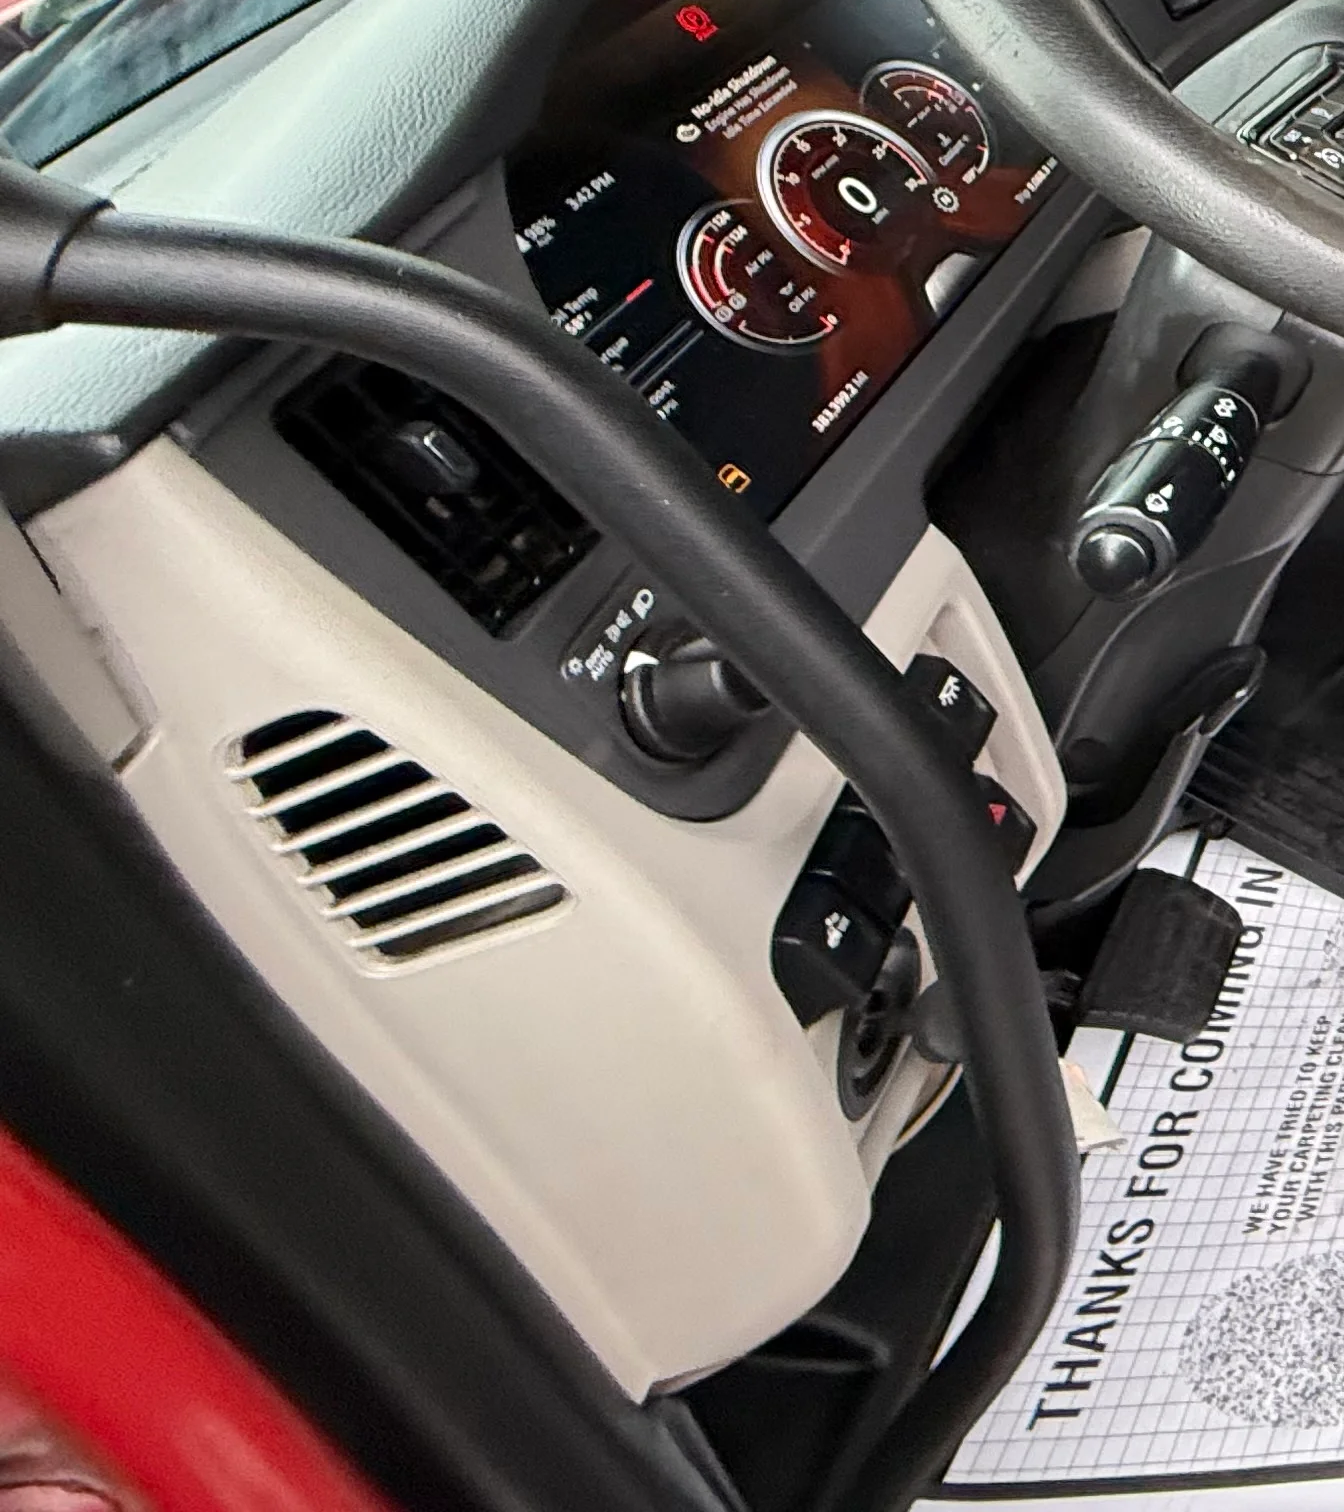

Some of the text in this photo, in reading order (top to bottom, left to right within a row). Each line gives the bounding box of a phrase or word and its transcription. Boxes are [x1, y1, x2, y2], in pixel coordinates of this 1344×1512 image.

[692, 56, 776, 118] No-Idle Shutdown
[784, 172, 800, 185] 10
[838, 177, 877, 213] 0
[599, 337, 628, 364] rque
[1027, 867, 1283, 1430] THANKS FOR COMING IN
[1242, 1015, 1332, 1234] WE HAVE TRIED TO KEEP
[1267, 1180, 1300, 1235] YOUR
[1289, 1073, 1337, 1173] CARPETING
[1296, 1171, 1327, 1222] WITH
[1316, 1122, 1343, 1165] THIS
